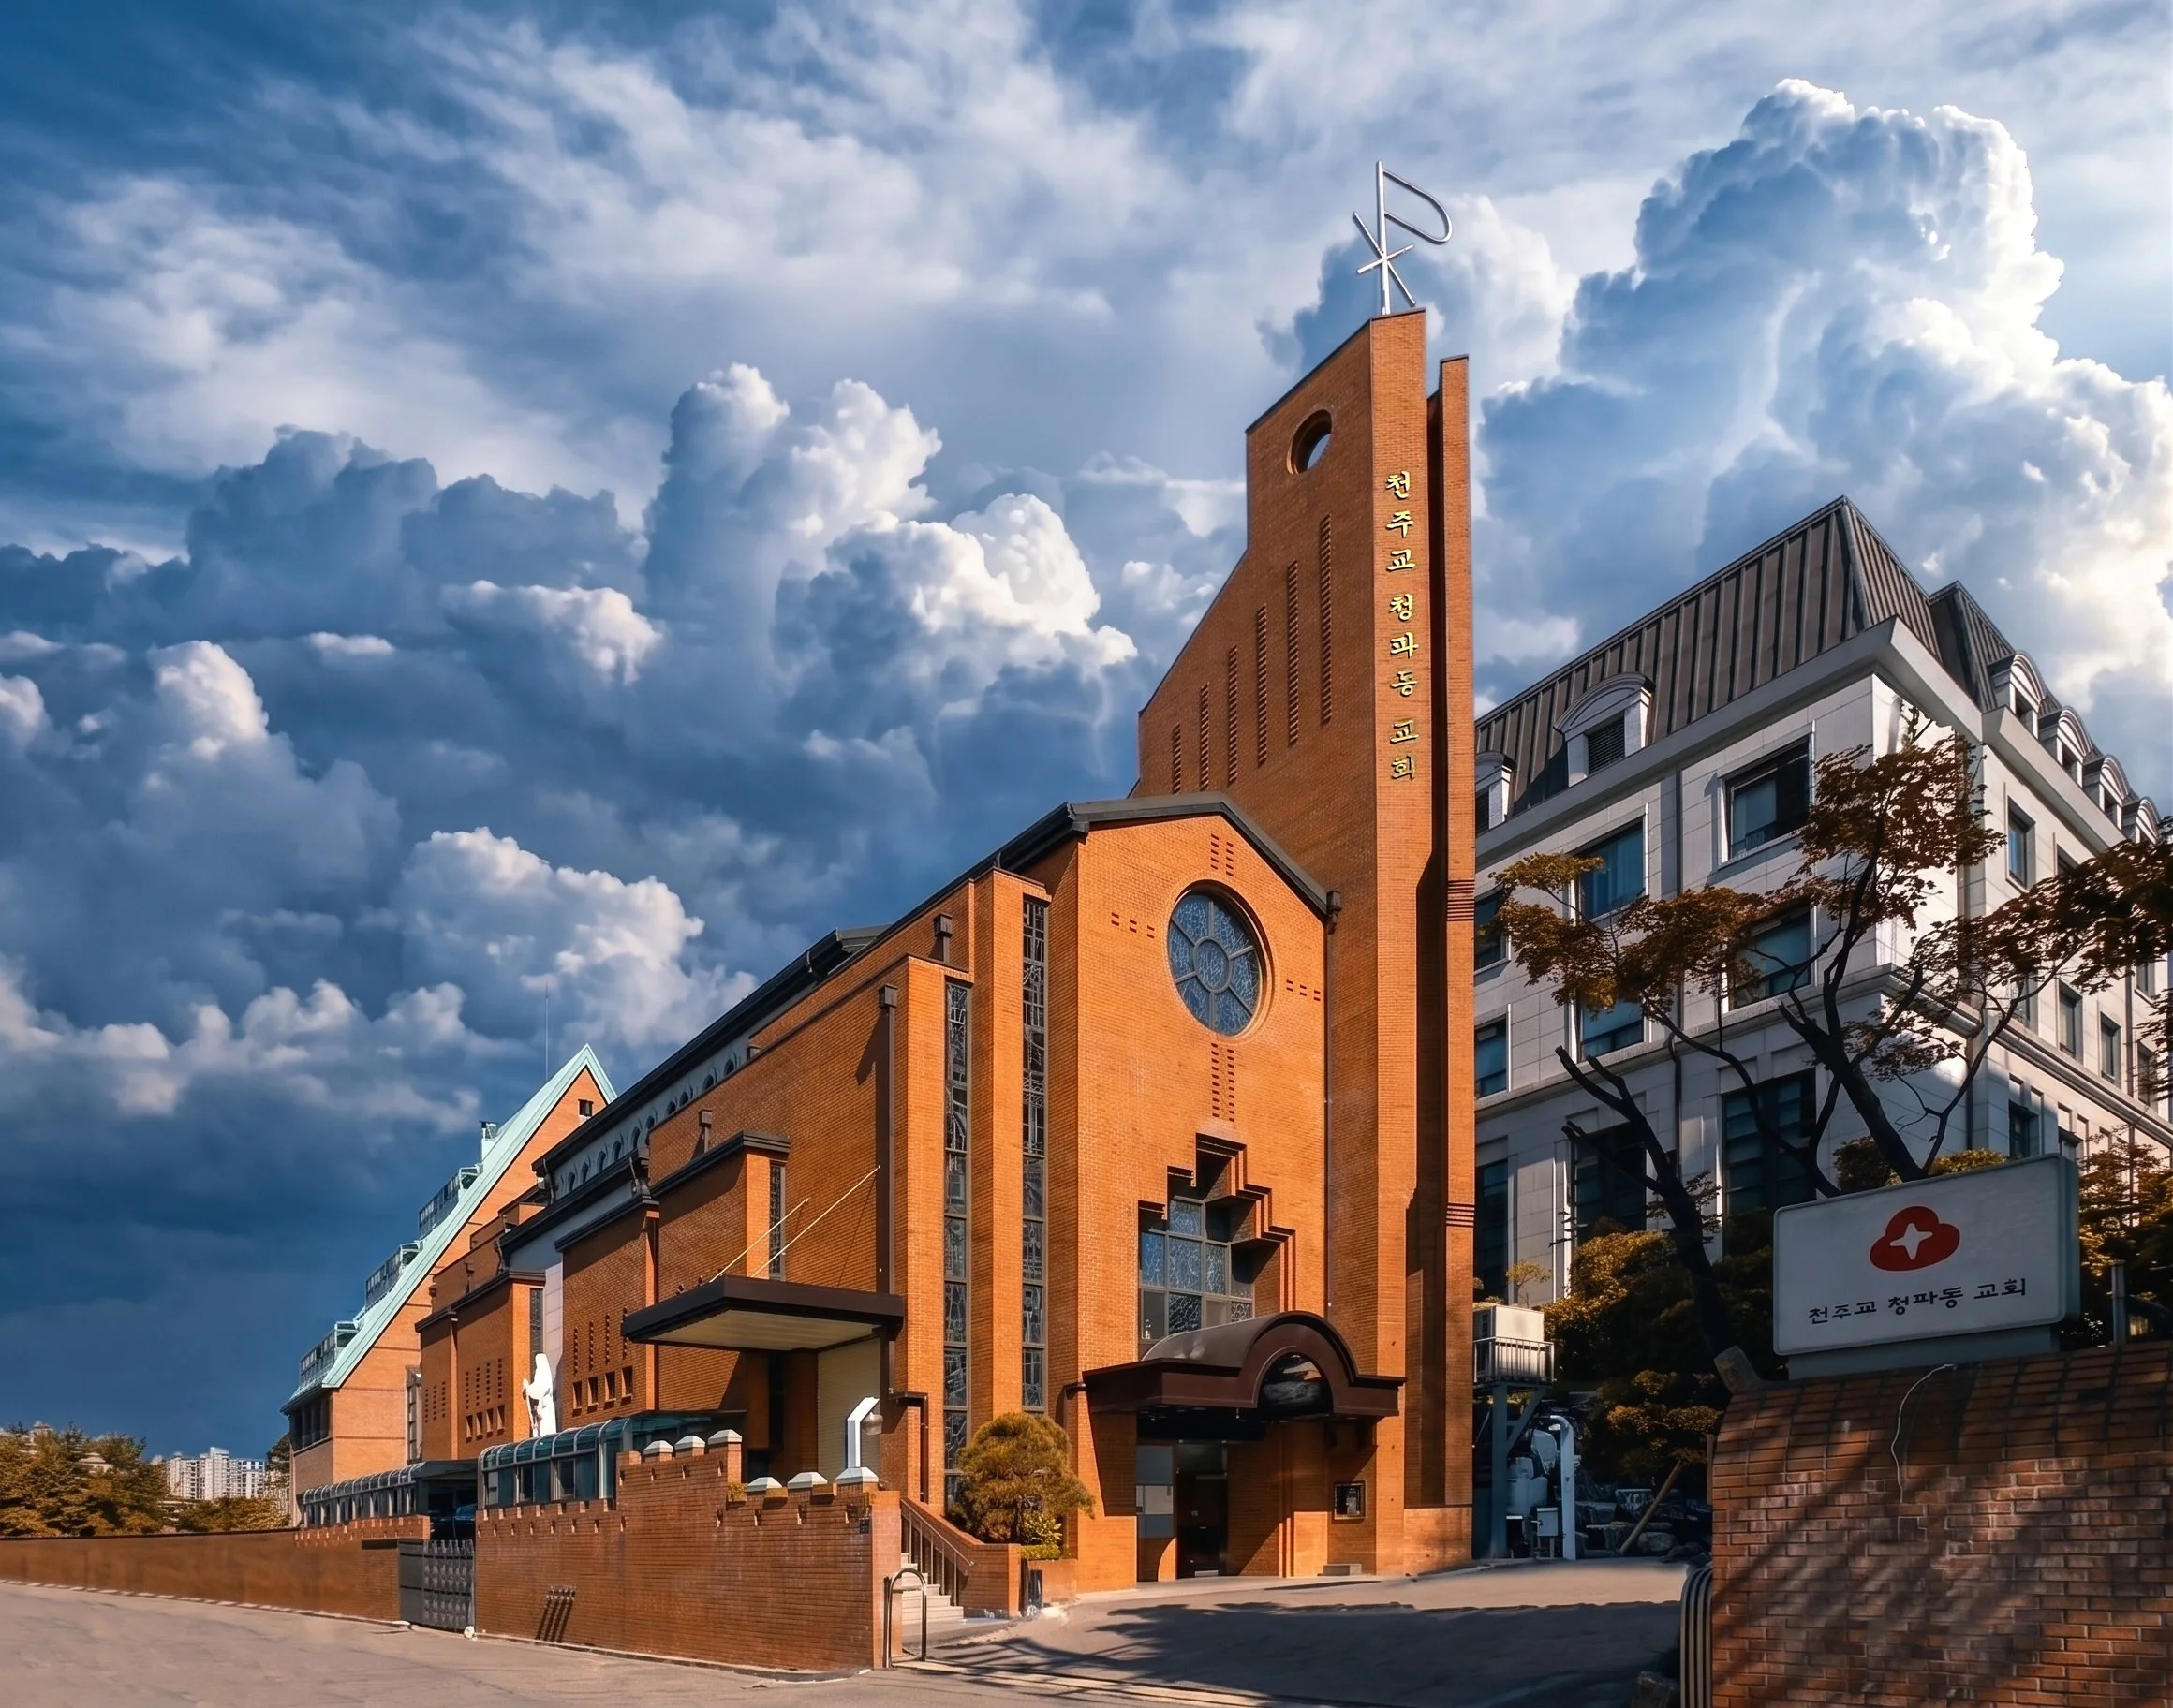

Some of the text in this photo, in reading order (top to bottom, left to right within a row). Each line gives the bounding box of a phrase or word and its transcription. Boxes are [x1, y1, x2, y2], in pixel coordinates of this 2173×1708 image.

[1386, 471, 1419, 780] 천주교 청파동 교회
[1809, 1278, 2026, 1325] 천주교 청파동 교회
